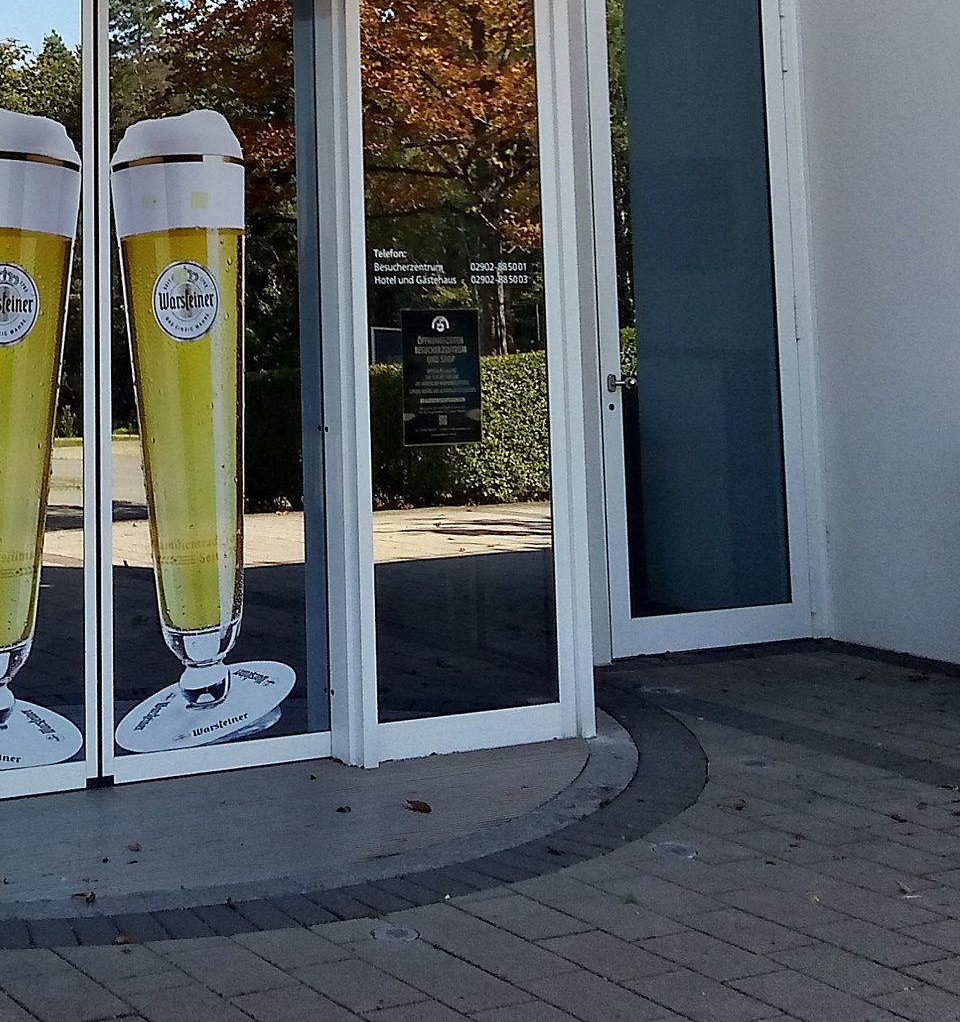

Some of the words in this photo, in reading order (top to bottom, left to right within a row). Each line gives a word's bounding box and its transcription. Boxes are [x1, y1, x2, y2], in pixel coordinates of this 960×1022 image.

[373, 248, 407, 258] Telefon:
[373, 262, 443, 272] Besucherzentrum
[374, 275, 398, 285] Hotel
[398, 275, 414, 285] und
[417, 275, 457, 285] Gästehaus
[158, 291, 214, 311] Warsteiner
[192, 713, 249, 737] Warsteiner
